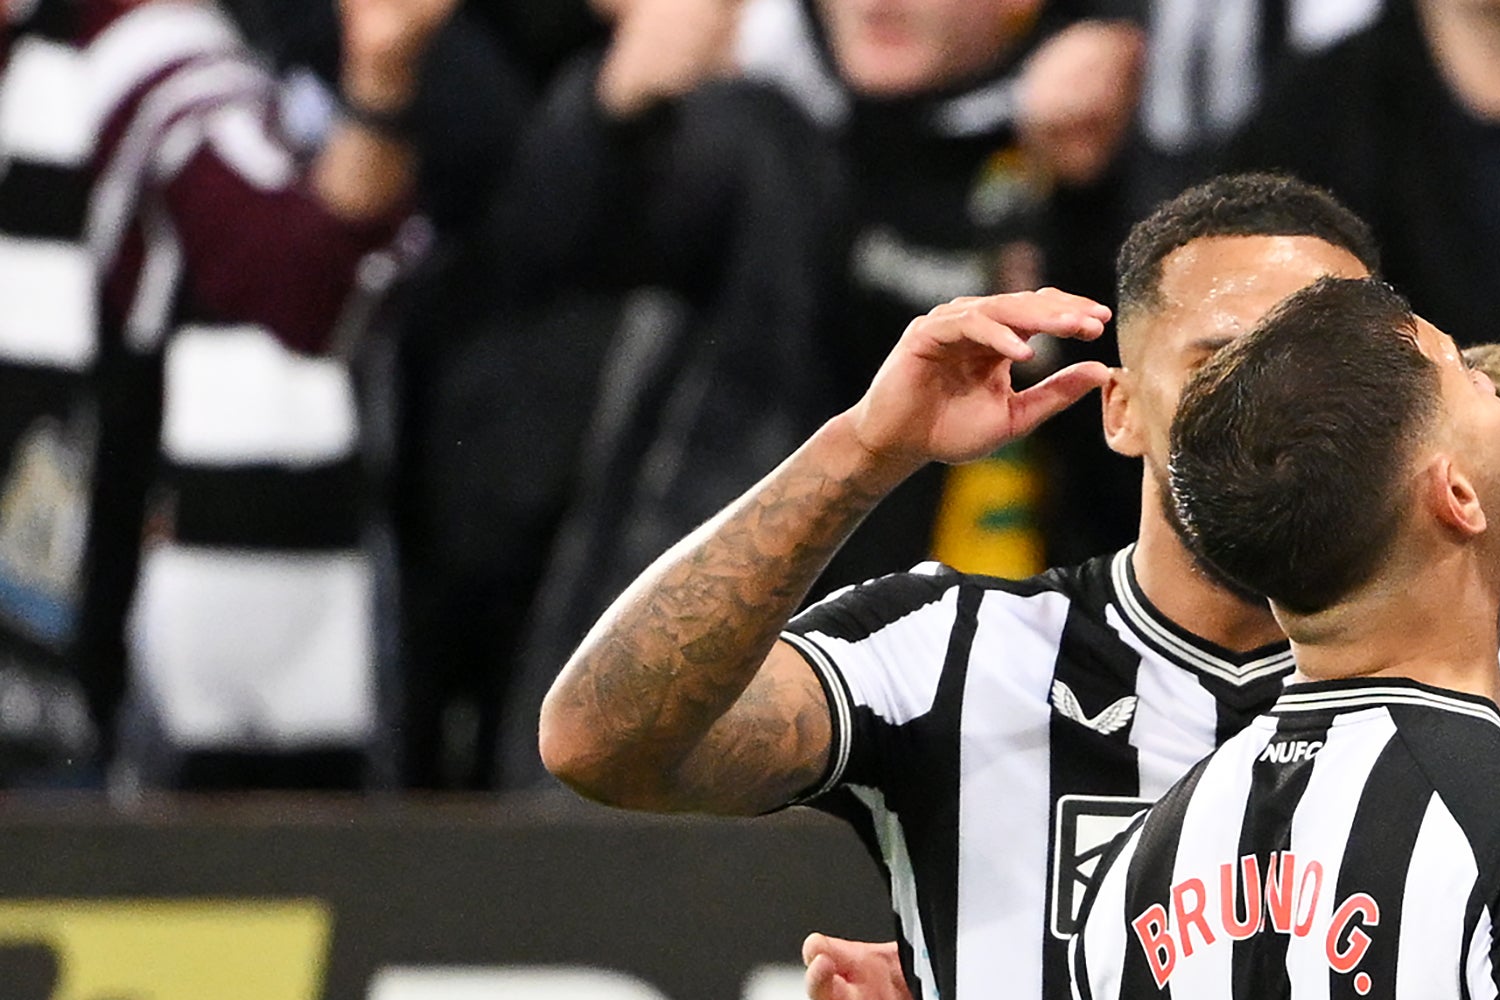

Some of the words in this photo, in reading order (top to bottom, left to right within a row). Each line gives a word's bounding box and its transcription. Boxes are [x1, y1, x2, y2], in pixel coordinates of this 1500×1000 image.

[1259, 741, 1323, 763] NUFC
[1131, 850, 1323, 990] BRUNO
[1325, 892, 1380, 995] G.
